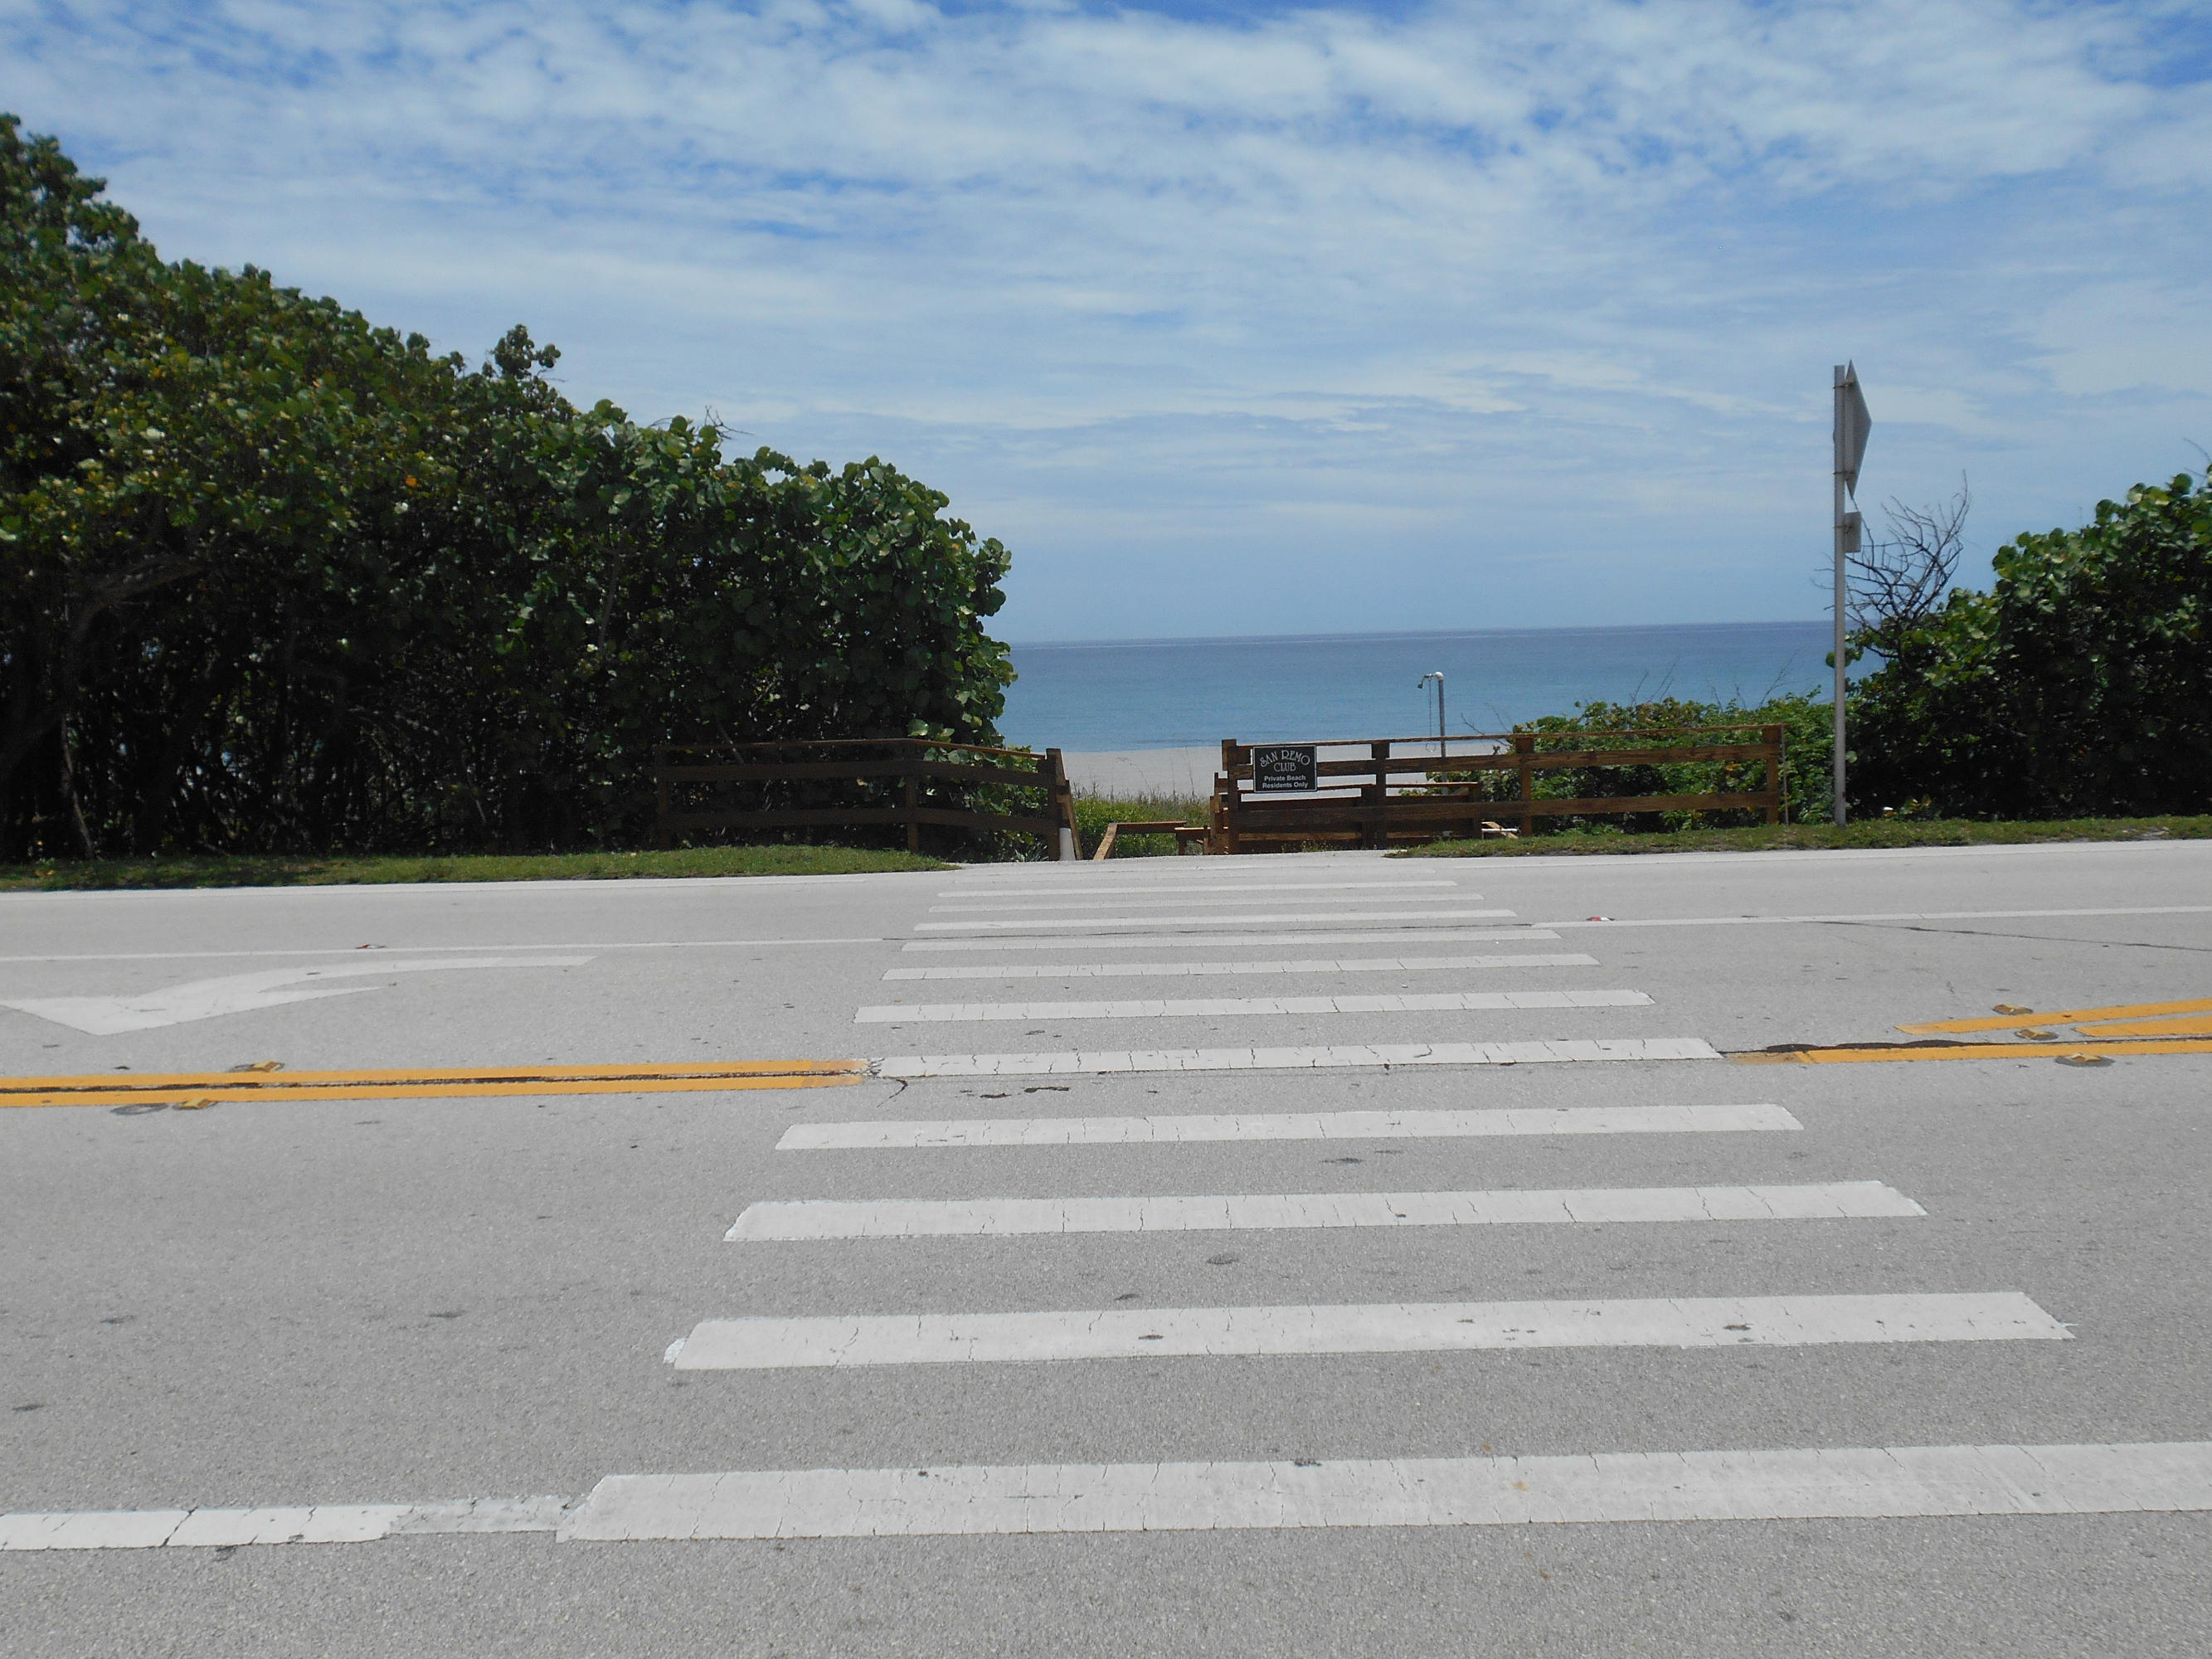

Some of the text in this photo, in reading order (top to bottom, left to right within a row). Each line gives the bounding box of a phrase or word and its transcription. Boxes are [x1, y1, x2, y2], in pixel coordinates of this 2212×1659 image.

[1259, 750, 1310, 767] SAN REMO
[1273, 762, 1296, 772] CLUB
